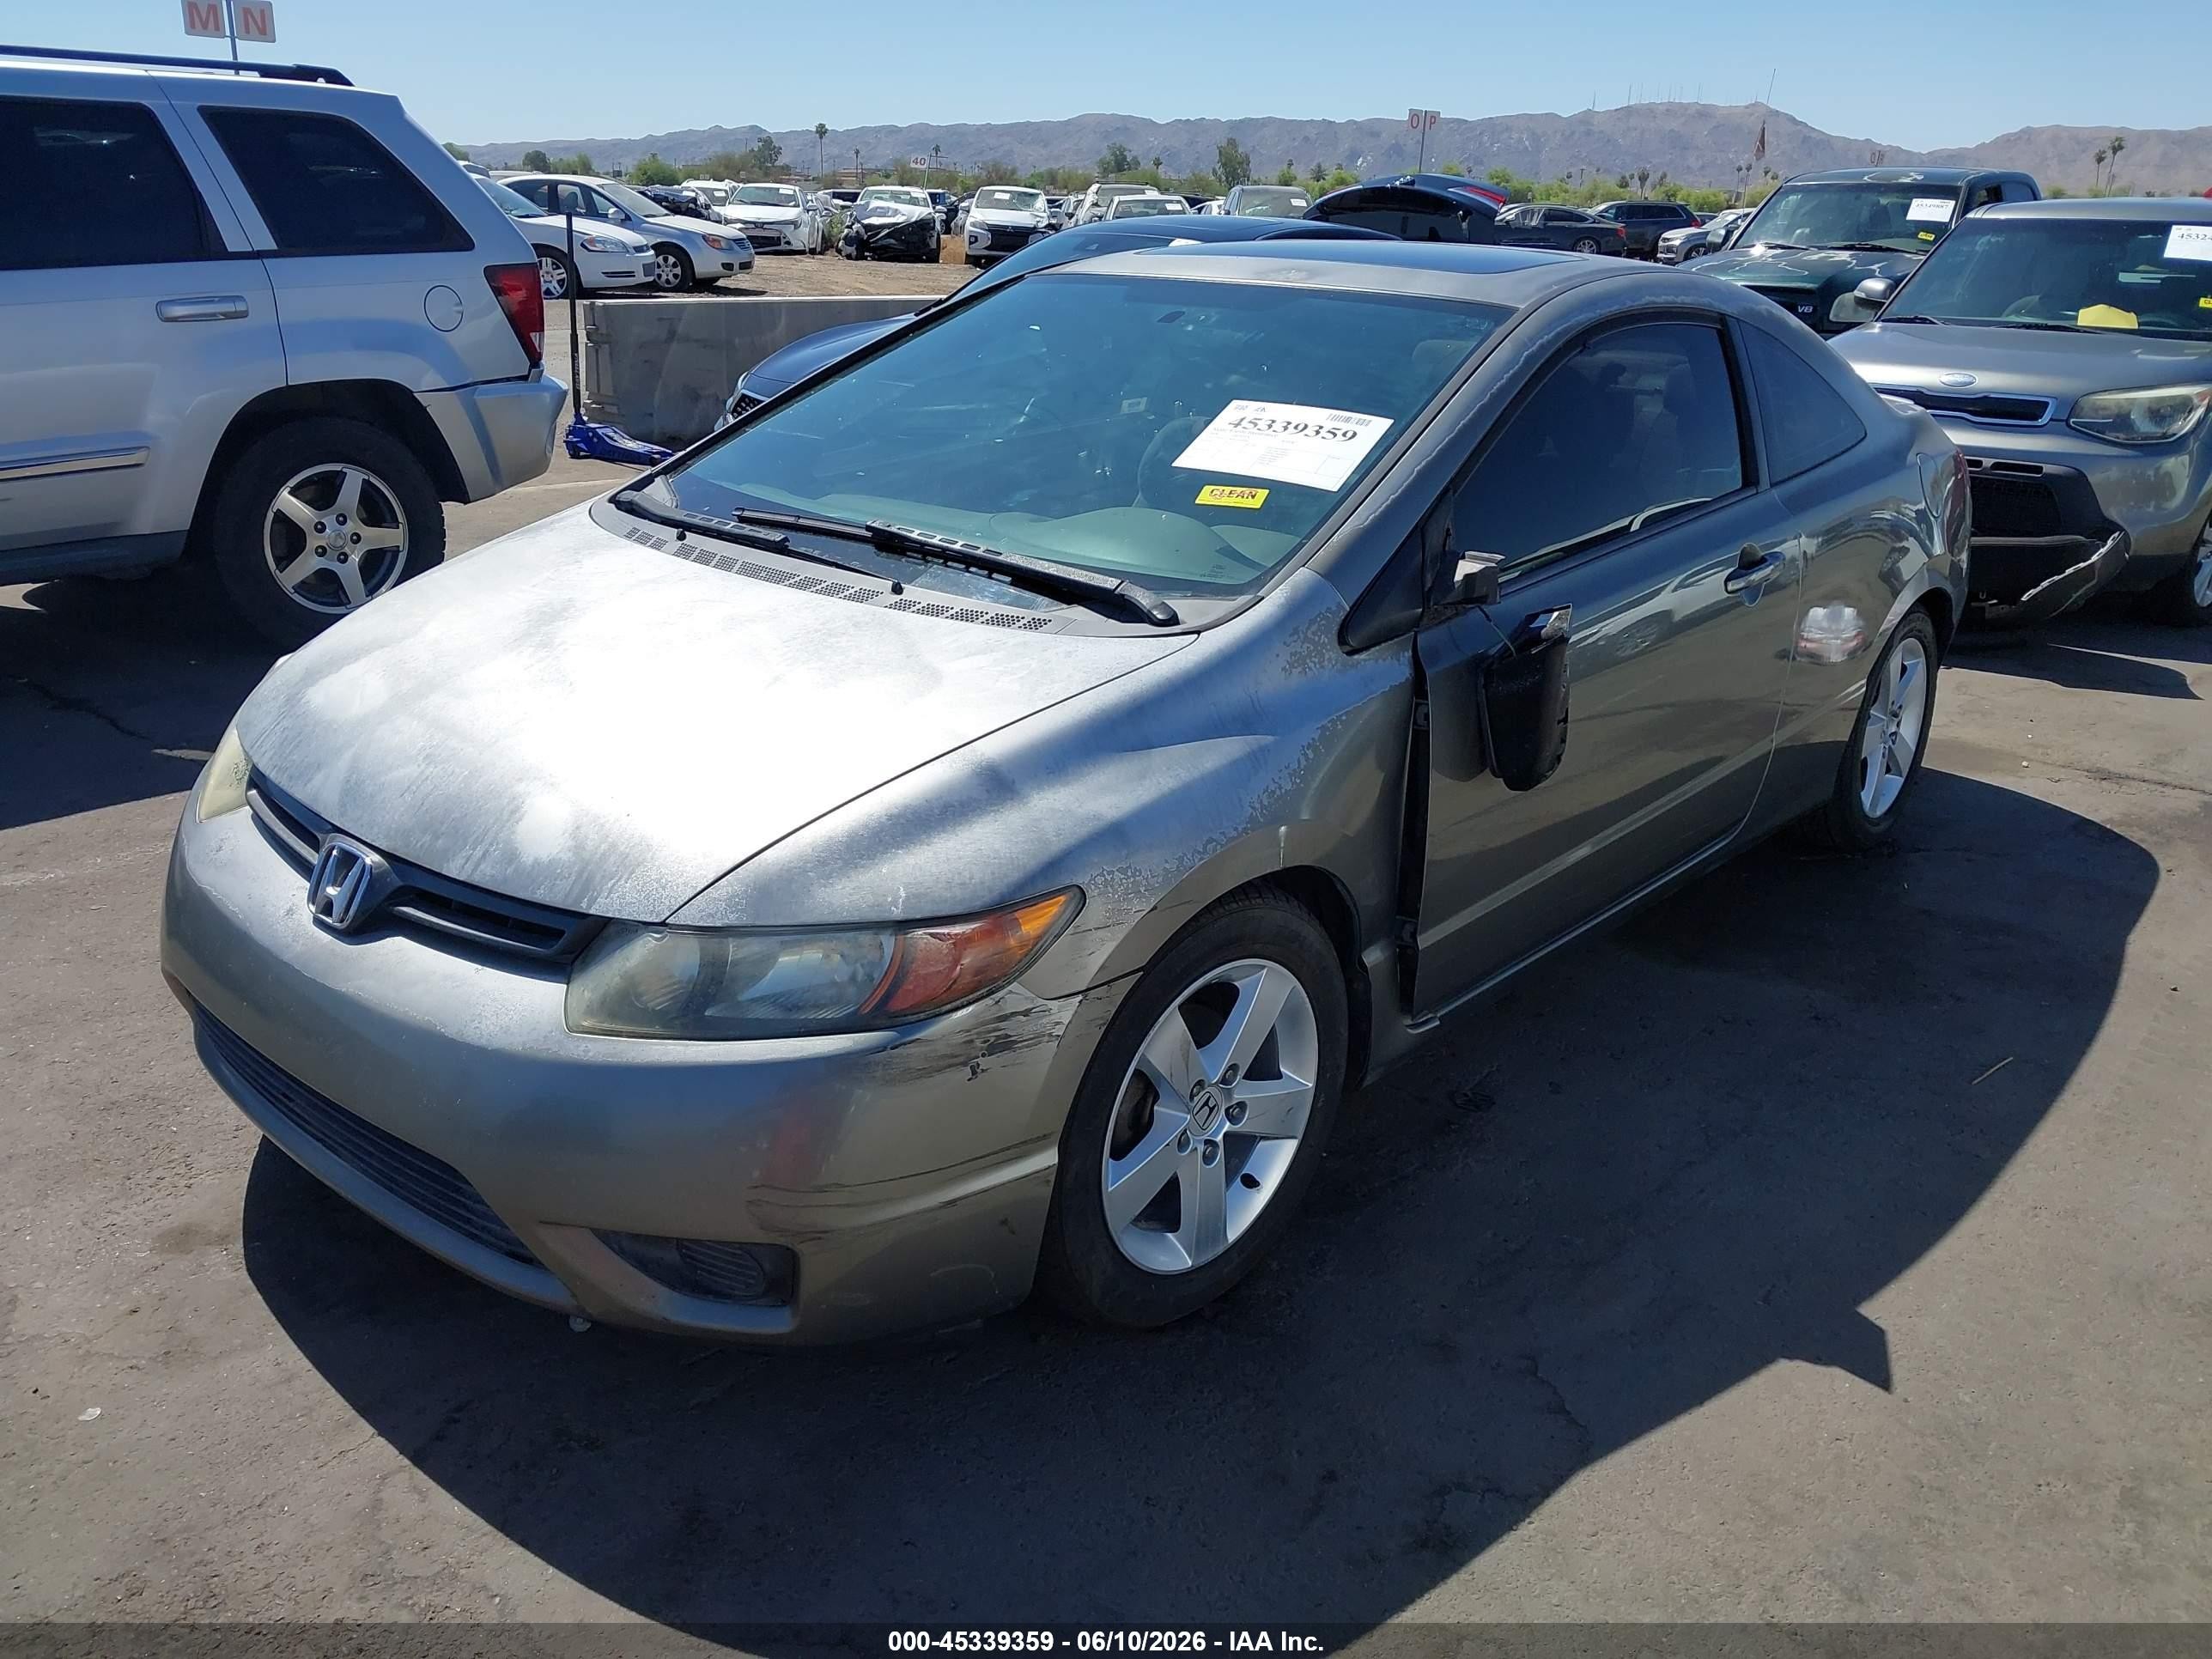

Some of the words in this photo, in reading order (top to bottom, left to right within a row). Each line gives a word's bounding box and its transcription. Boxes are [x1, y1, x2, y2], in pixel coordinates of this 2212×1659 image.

[185, 2, 221, 32] M
[242, 7, 267, 36] N
[1411, 113, 1420, 129] O
[1429, 115, 1437, 131] P
[912, 157, 927, 166] 40
[1797, 305, 1814, 313] V8
[1228, 416, 1358, 442] 45339359
[1209, 488, 1258, 500] CLEAN
